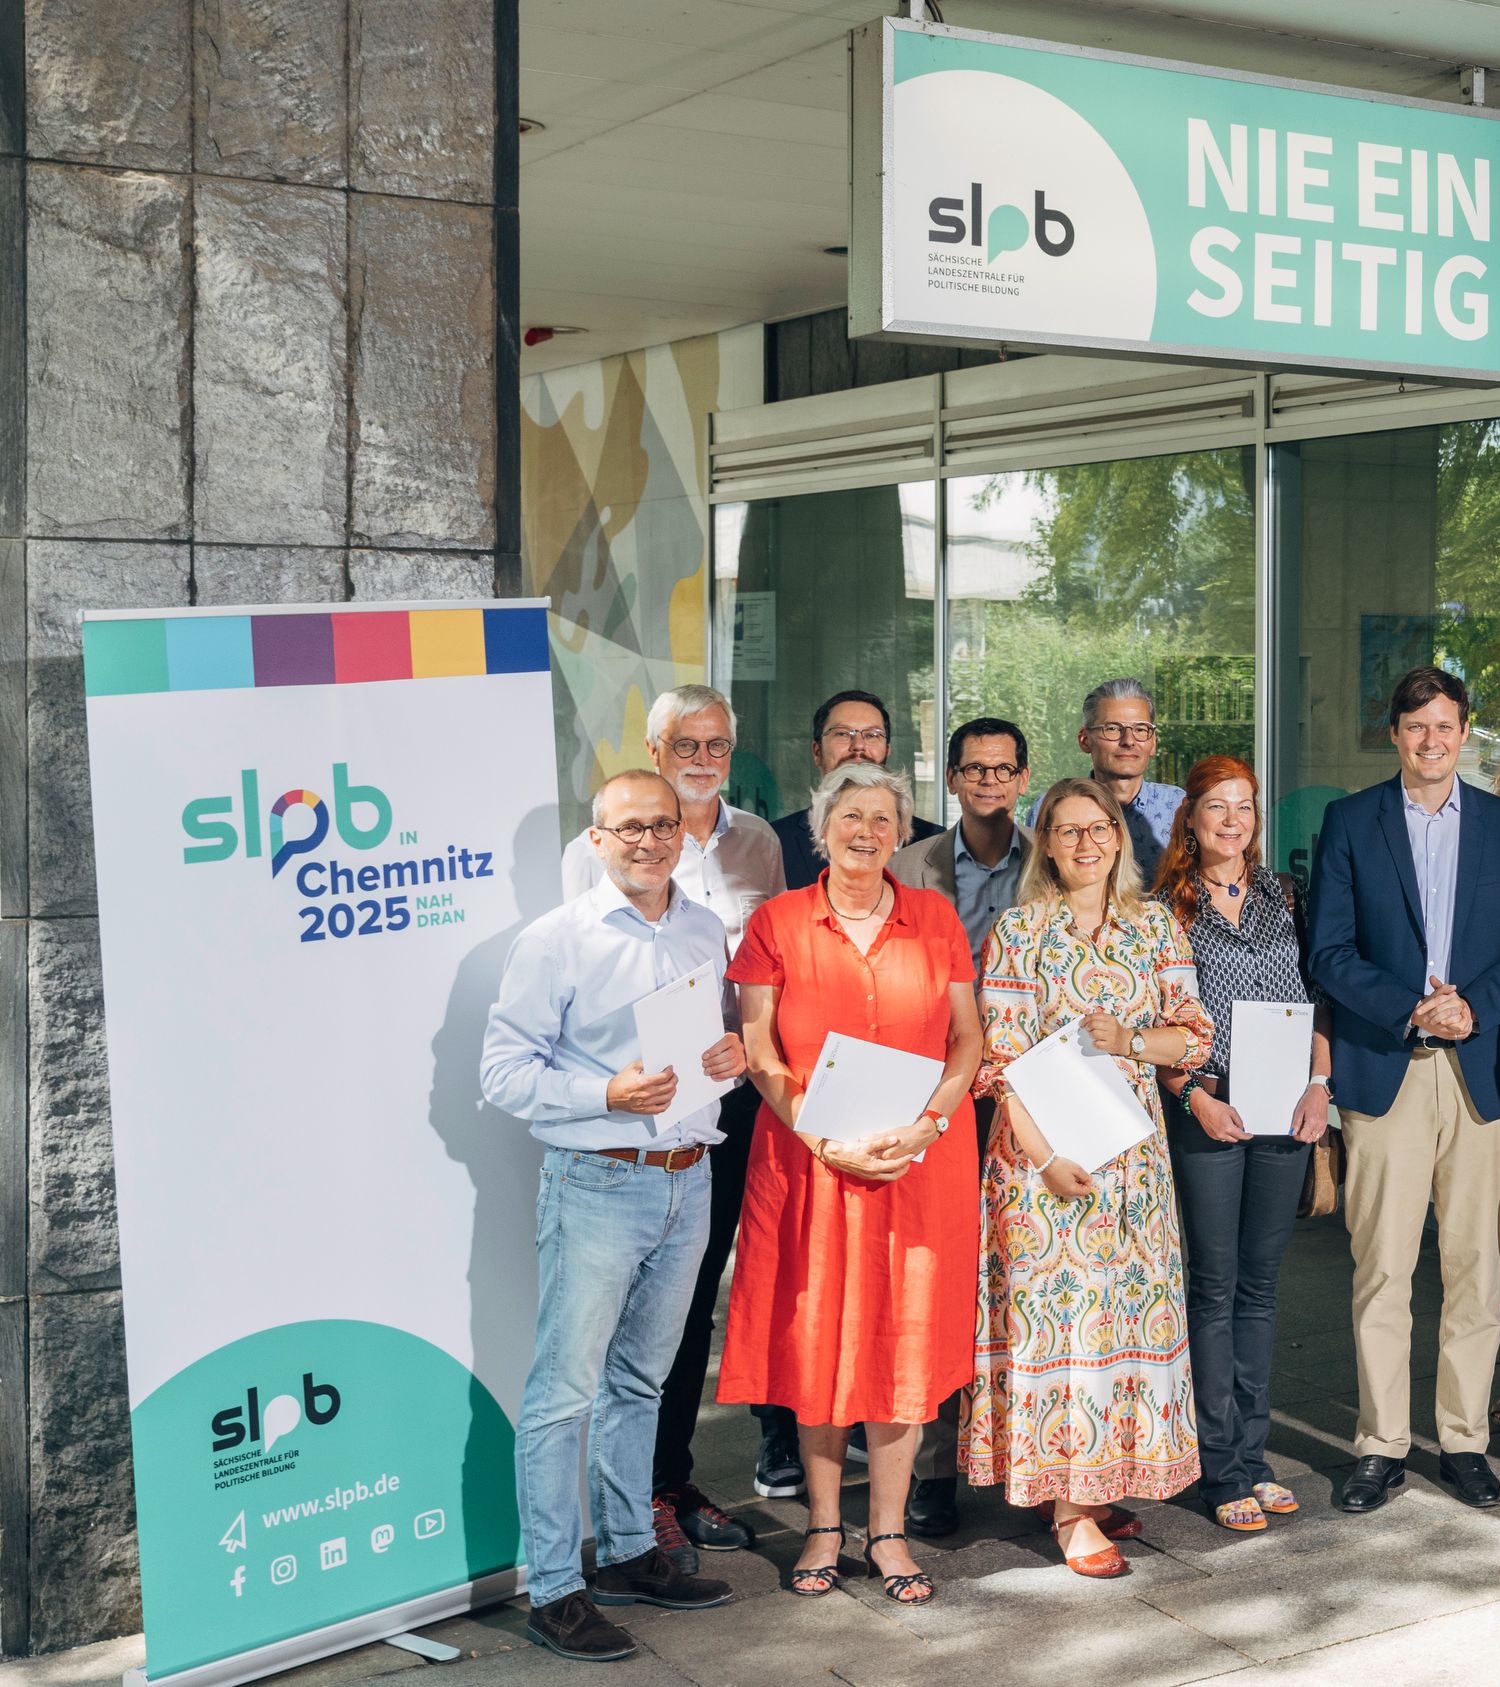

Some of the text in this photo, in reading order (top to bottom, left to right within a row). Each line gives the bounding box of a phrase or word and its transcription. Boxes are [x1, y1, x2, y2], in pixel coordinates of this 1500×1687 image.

[1187, 117, 1490, 242] NIE EIN
[928, 182, 1075, 265] slpb
[928, 252, 983, 267] SÄCHSISCHE
[928, 266, 1025, 284] LANDESZENTRALE FÜR
[928, 279, 1020, 297] POLITISCHE BILDUNG
[1186, 225, 1489, 341] SEITIG
[181, 762, 418, 880] slpb IN
[296, 844, 494, 898] Chemnitz
[298, 895, 411, 943] 2025
[416, 892, 453, 910] NAH
[417, 909, 466, 928] DRAN
[211, 1372, 341, 1454] slpb
[213, 1448, 262, 1469] SÄCHSISCHE
[214, 1449, 300, 1480] LANDESZENTRALE FÜR
[215, 1461, 296, 1491] POLITISCHE BILDUNG
[262, 1473, 400, 1529] www.slpb.de
